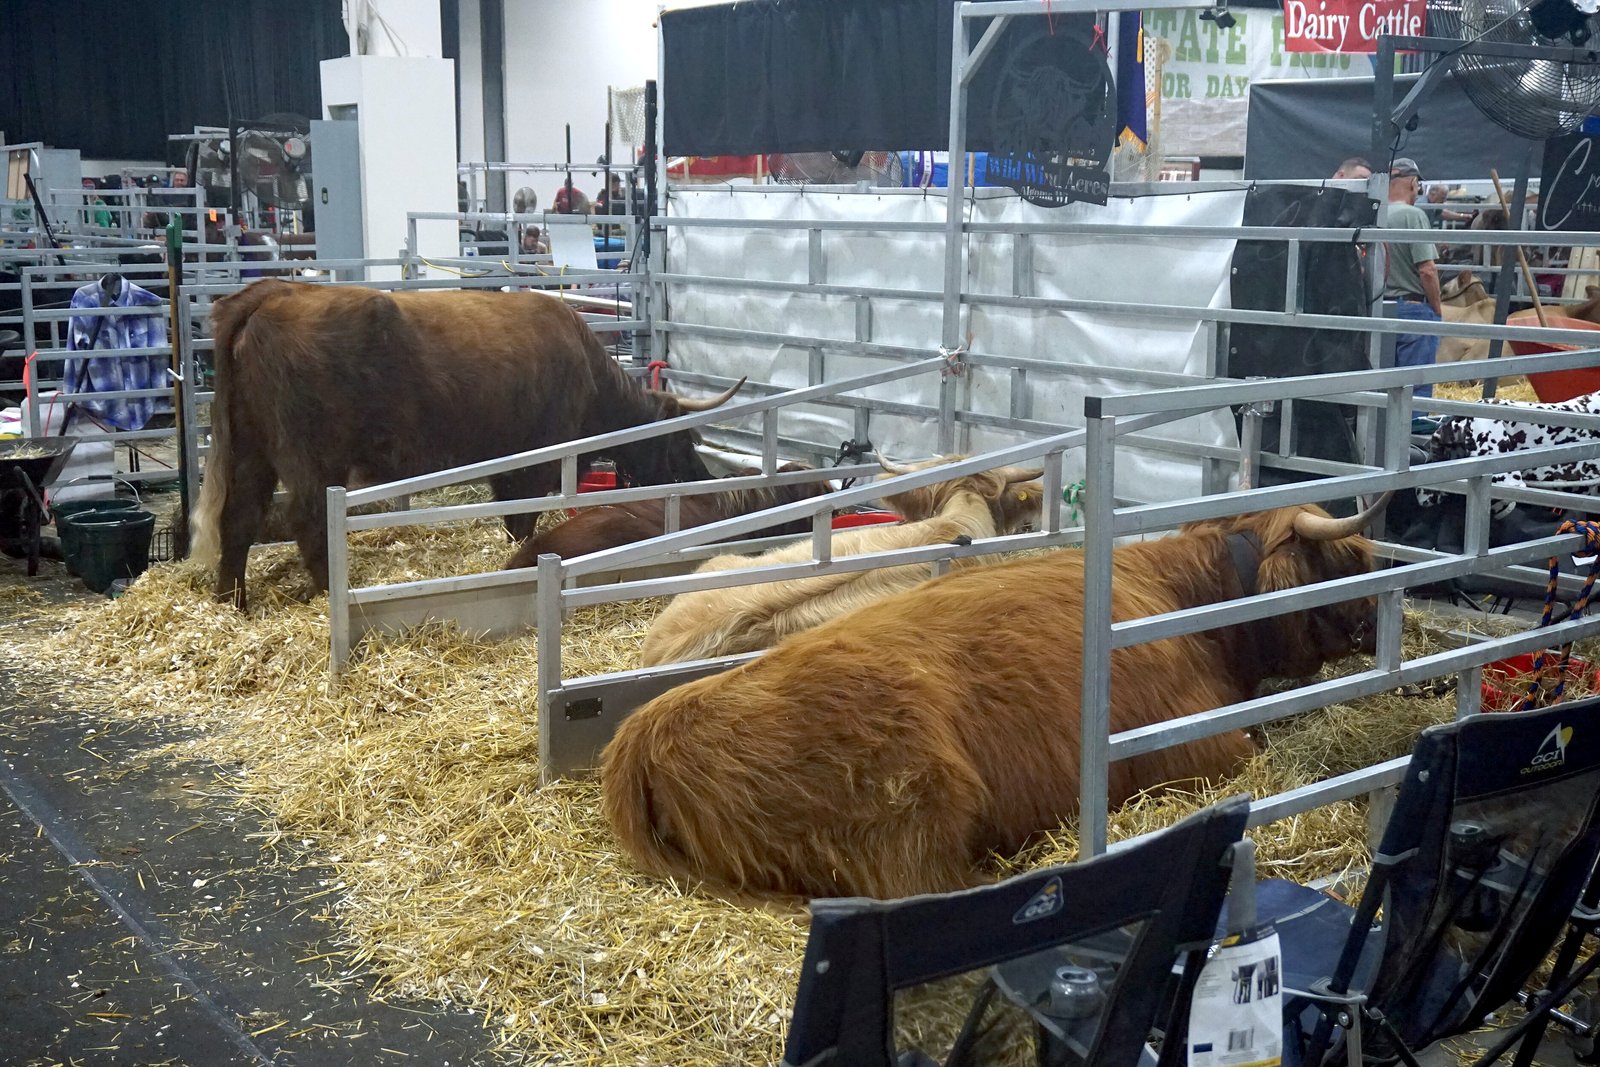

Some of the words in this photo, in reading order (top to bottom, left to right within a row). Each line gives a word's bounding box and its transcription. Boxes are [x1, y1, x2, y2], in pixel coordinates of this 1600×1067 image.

[1287, 0, 1350, 53] Dairy
[1359, 2, 1422, 41] Cattle
[1162, 72, 1192, 98] OR
[1205, 74, 1250, 98] DAY
[989, 156, 1022, 181] Wild
[1064, 171, 1108, 196] Acres
[1531, 749, 1561, 766] GCI
